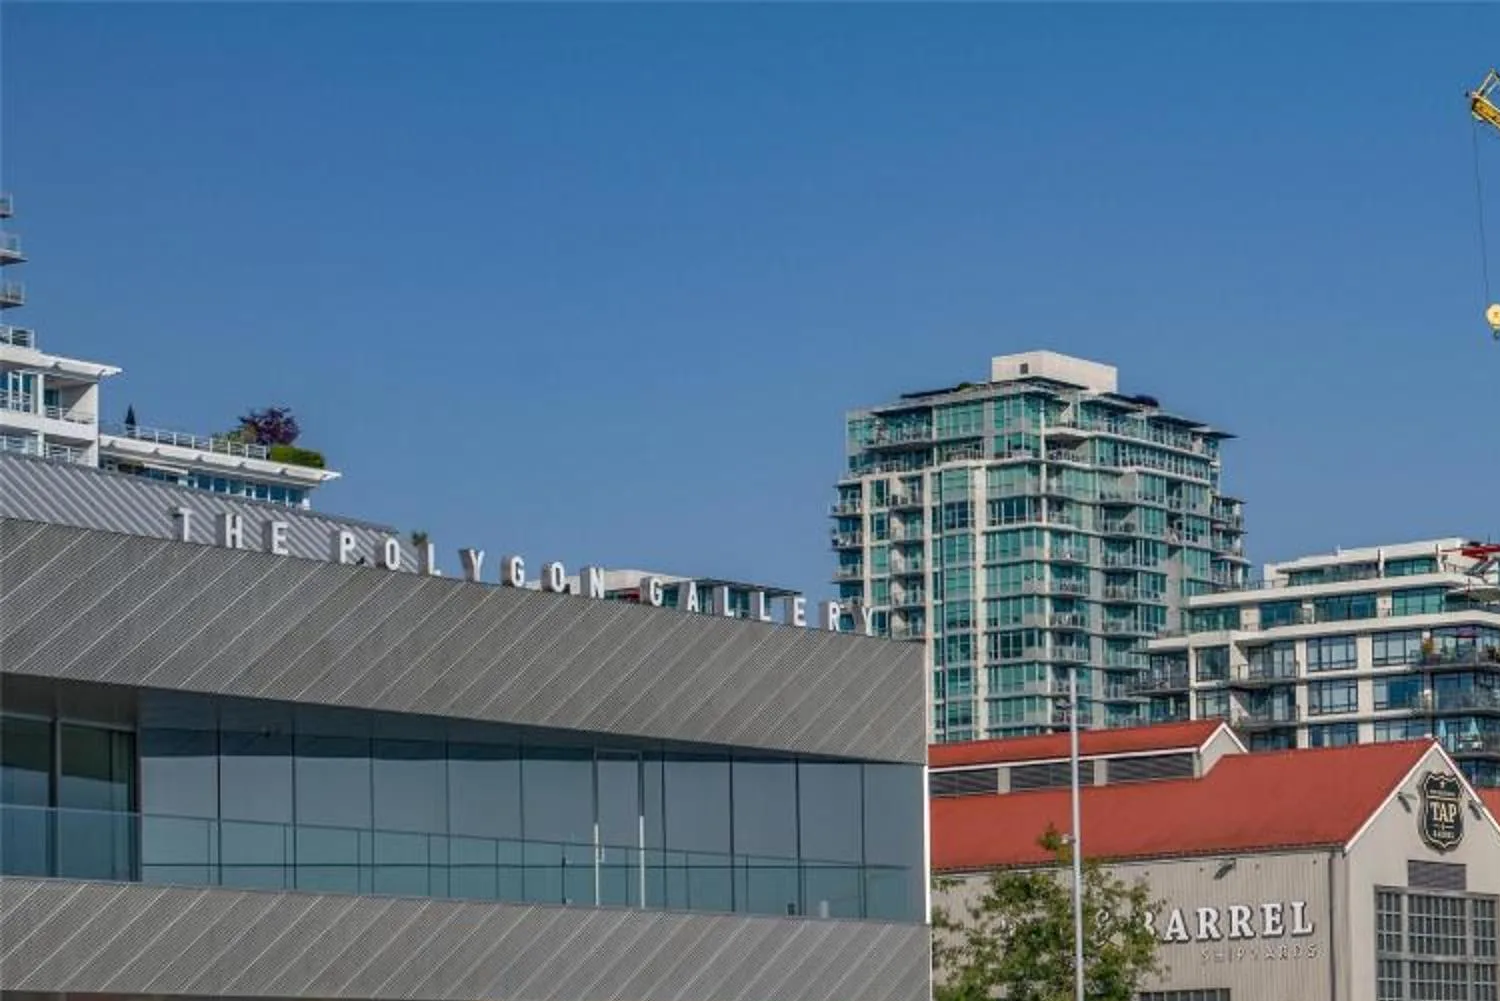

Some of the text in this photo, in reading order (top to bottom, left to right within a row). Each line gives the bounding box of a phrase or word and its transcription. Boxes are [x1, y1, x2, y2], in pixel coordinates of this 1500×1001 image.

[175, 507, 874, 638] THE POLYGON GALLERY
[1430, 802, 1457, 823] TAP
